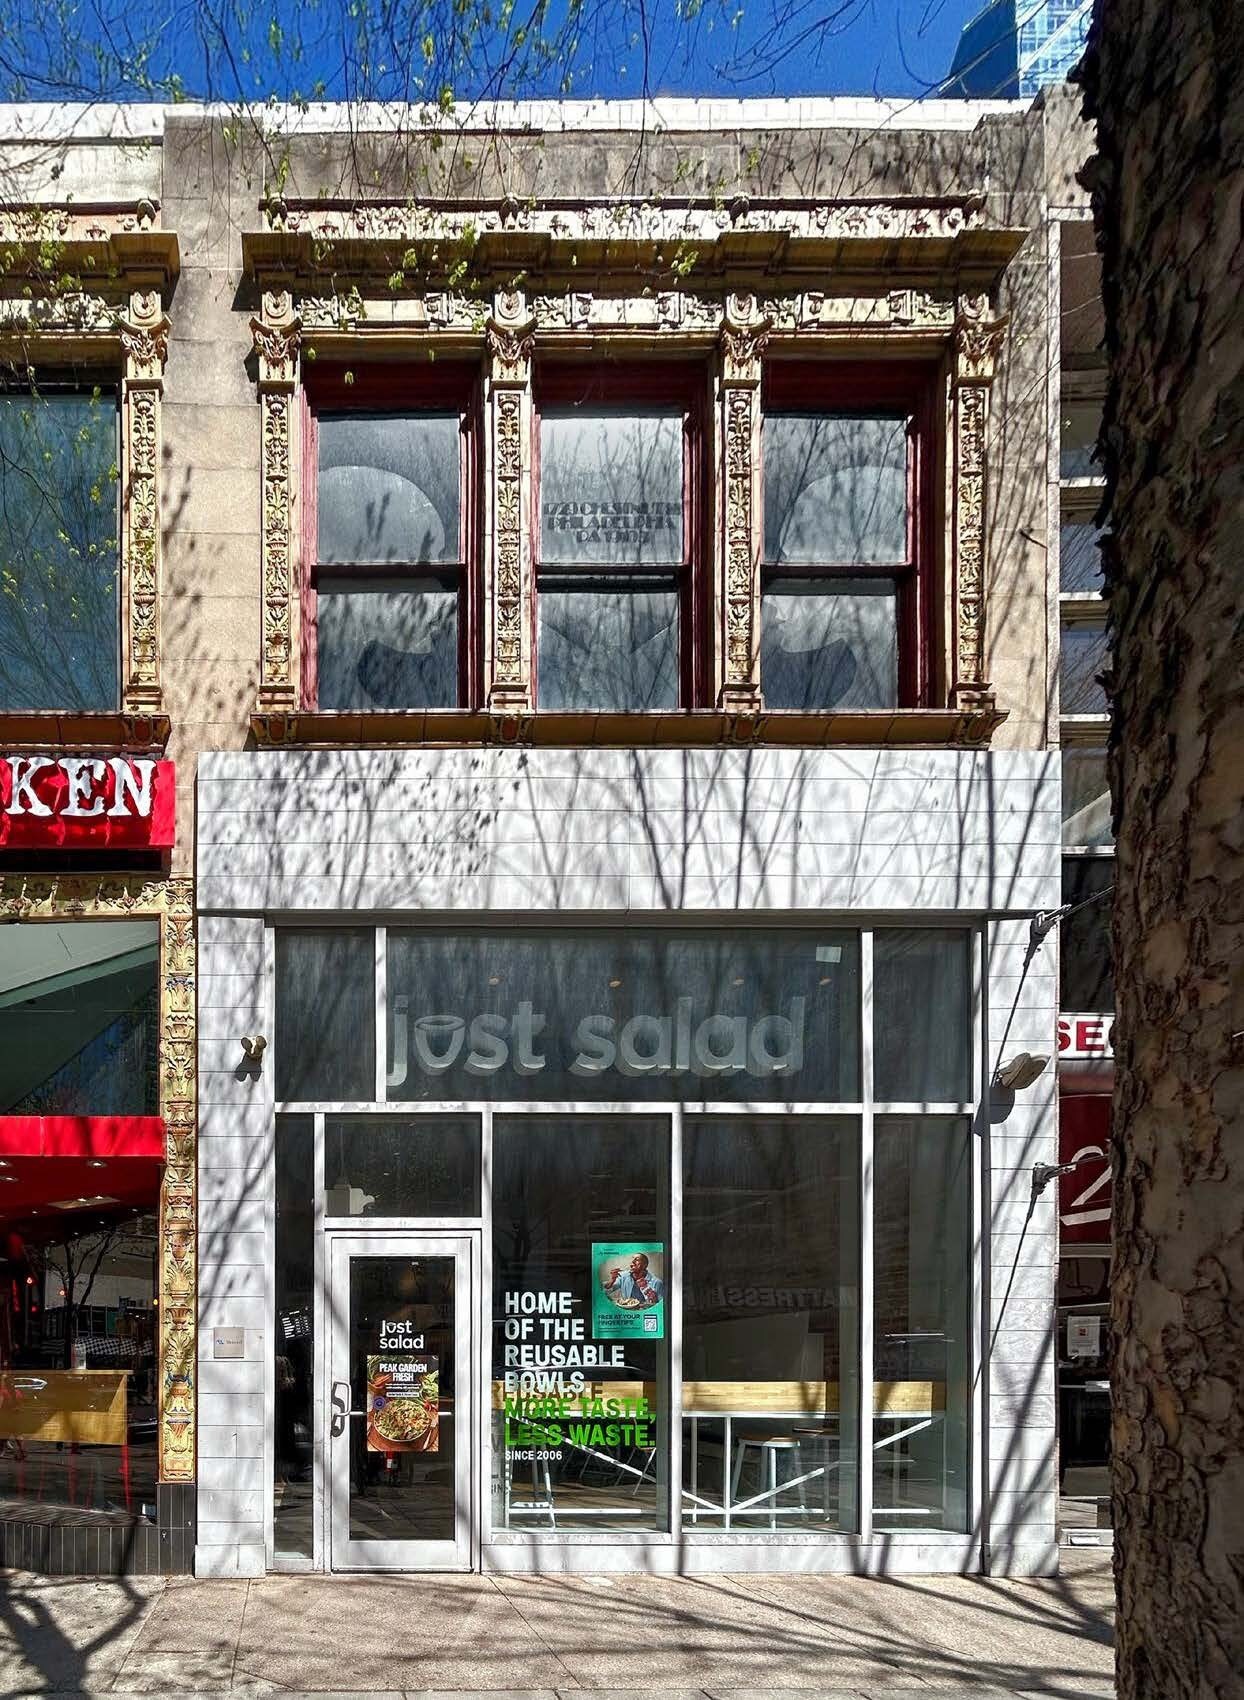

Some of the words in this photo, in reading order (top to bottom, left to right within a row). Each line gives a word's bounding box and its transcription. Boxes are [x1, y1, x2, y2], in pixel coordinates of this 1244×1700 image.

[5, 756, 157, 817] KEN
[570, 997, 803, 1077] salad
[504, 1291, 572, 1314] HOME
[379, 1319, 413, 1337] just
[504, 1318, 534, 1340] OF
[539, 1318, 585, 1340] THE
[379, 1334, 424, 1349] salad
[504, 1344, 625, 1367] REUSABLE
[379, 1363, 398, 1373] PEAK
[398, 1363, 428, 1373] GARDEN
[392, 1372, 414, 1382] FRESH
[504, 1371, 585, 1393] BOWLS
[504, 1397, 571, 1420] MORE
[580, 1397, 657, 1424] TASTE,
[504, 1424, 563, 1446] LESS
[568, 1424, 656, 1446] WASTE.
[504, 1450, 534, 1461] SINCE
[536, 1450, 563, 1461] 2006
